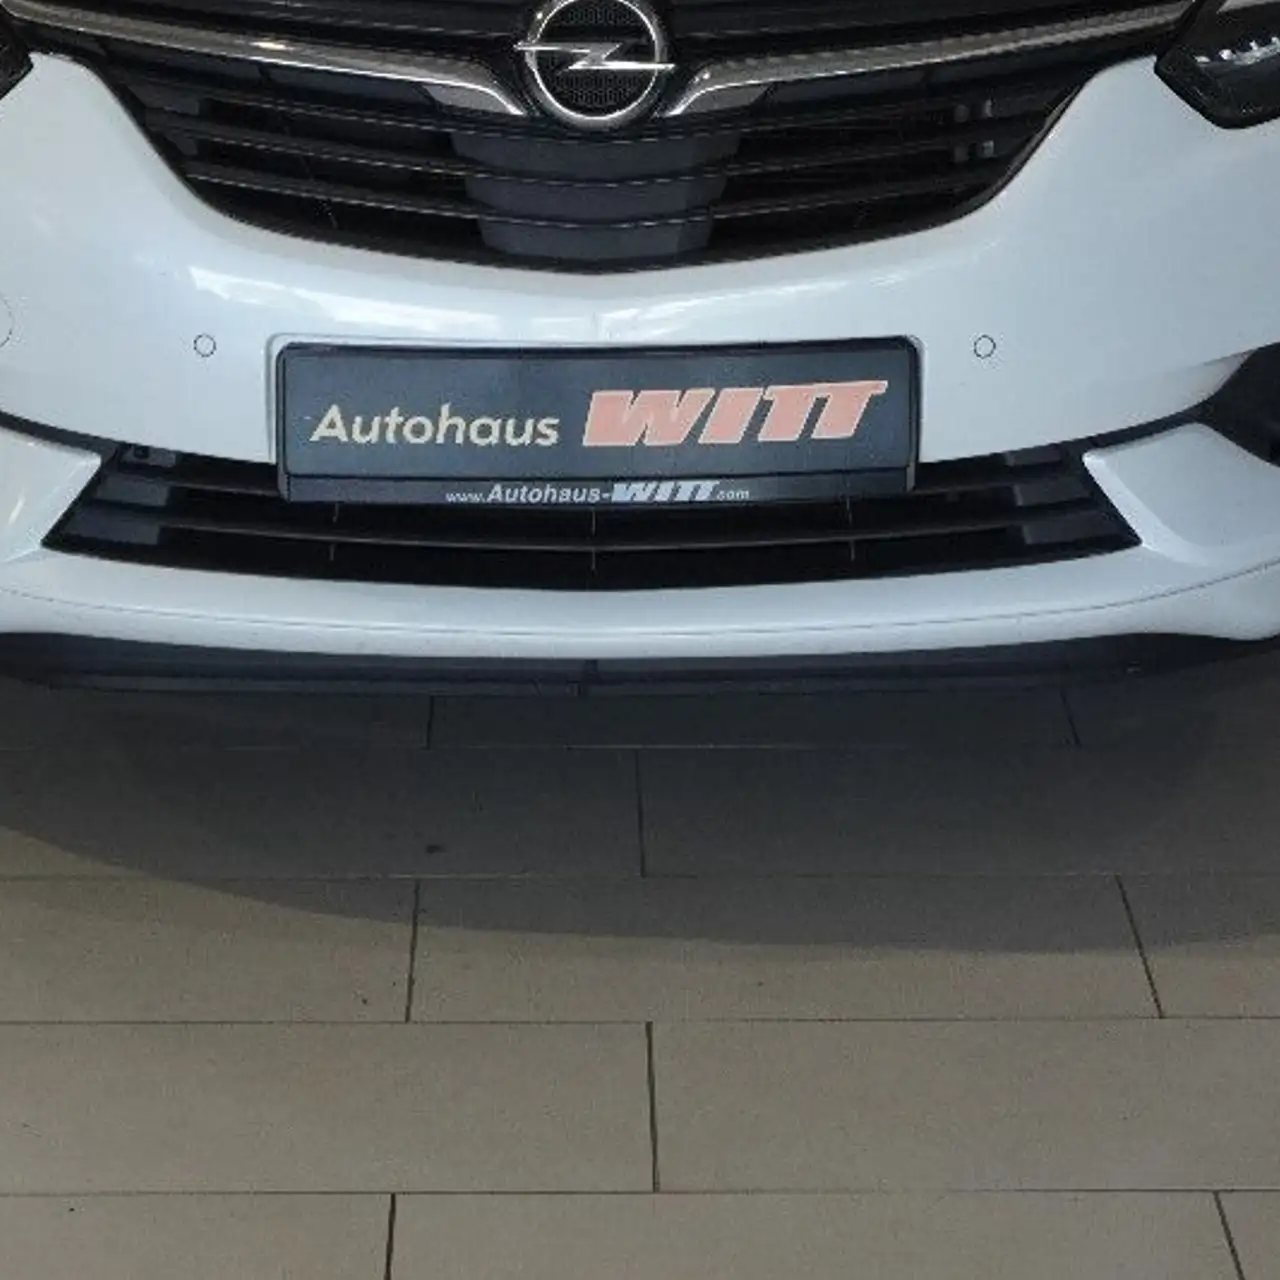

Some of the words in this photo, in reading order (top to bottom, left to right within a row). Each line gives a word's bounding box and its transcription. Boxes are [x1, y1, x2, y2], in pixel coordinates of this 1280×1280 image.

[309, 401, 560, 447] Autohaus
[582, 379, 889, 447] WITT
[445, 479, 751, 504] www.Autohaus-WITT.com
